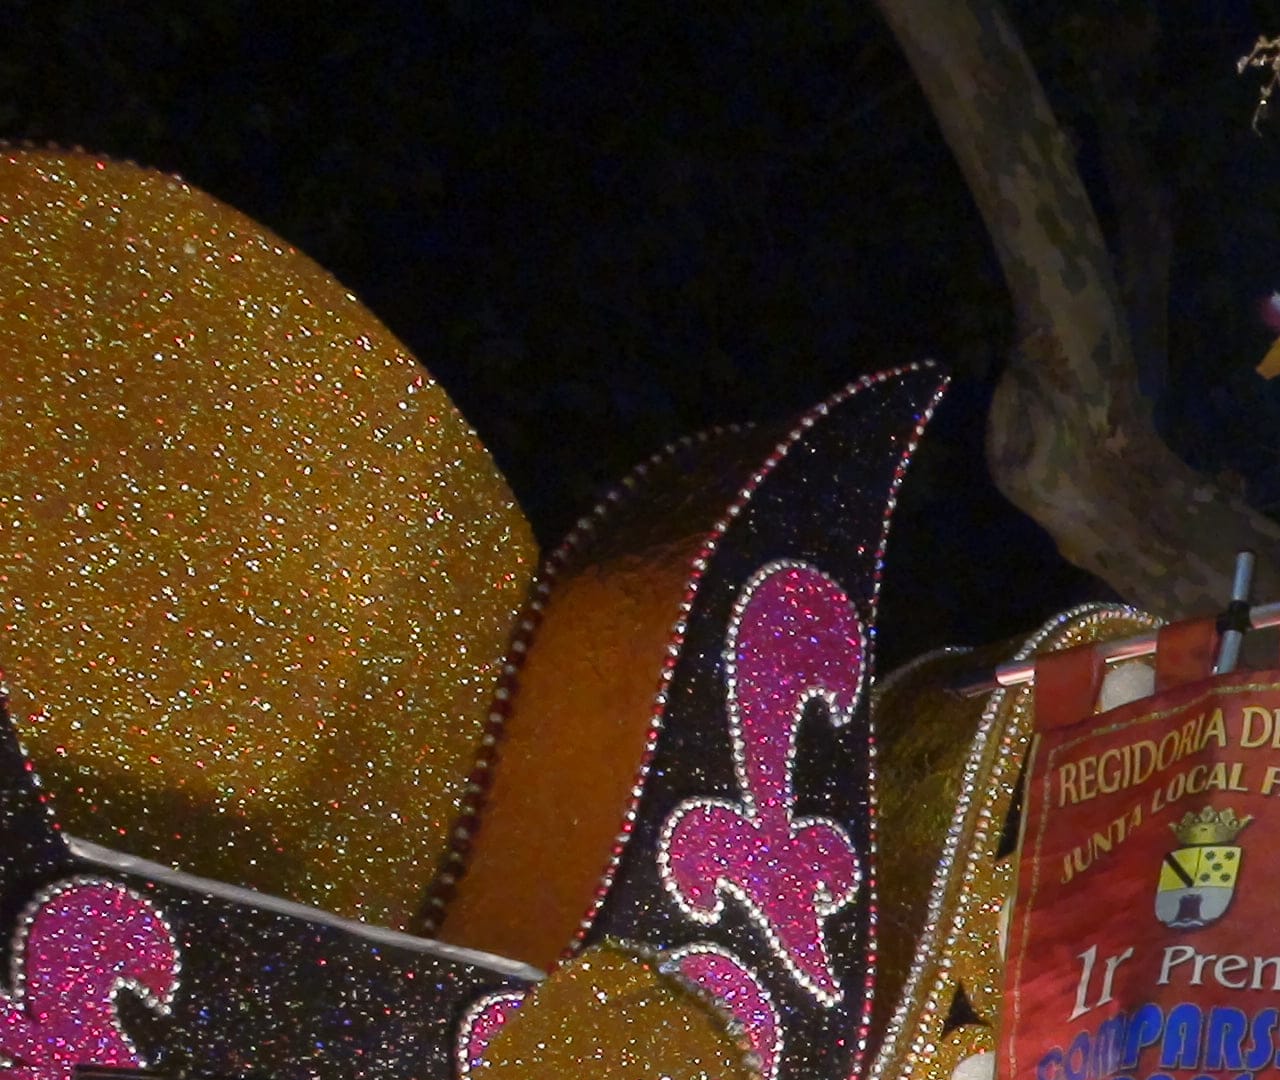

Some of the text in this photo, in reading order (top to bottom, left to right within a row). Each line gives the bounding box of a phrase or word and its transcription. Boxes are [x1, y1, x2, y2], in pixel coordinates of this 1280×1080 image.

[1058, 709, 1227, 808] REGIDORIA
[1060, 804, 1142, 885] JUNTA
[1152, 762, 1249, 815] LOCAL
[1067, 944, 1134, 1022] 1r
